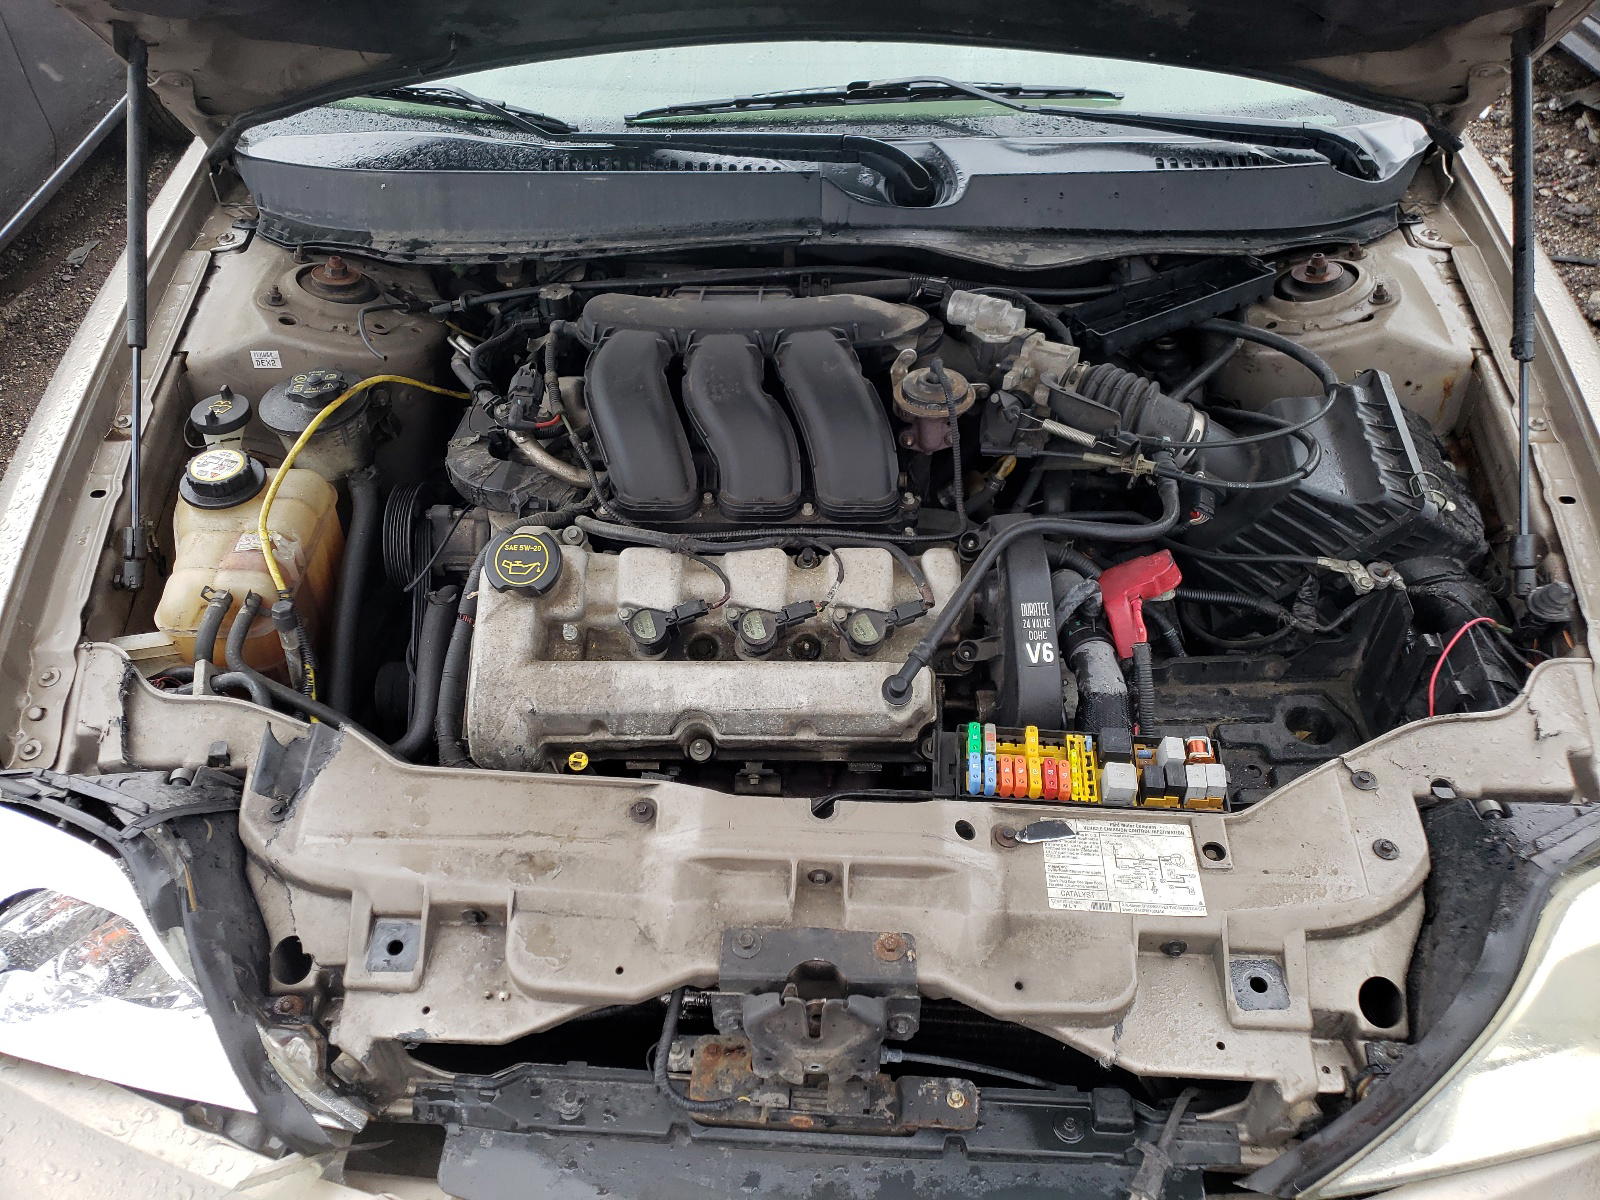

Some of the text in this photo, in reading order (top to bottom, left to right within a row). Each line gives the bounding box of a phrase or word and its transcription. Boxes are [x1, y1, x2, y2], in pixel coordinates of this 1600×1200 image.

[519, 544, 542, 552] 5W-20
[1020, 602, 1050, 616] DURATEC
[1022, 620, 1030, 628] 24
[1026, 642, 1054, 664] V6
[1060, 890, 1095, 898] CATALYST
